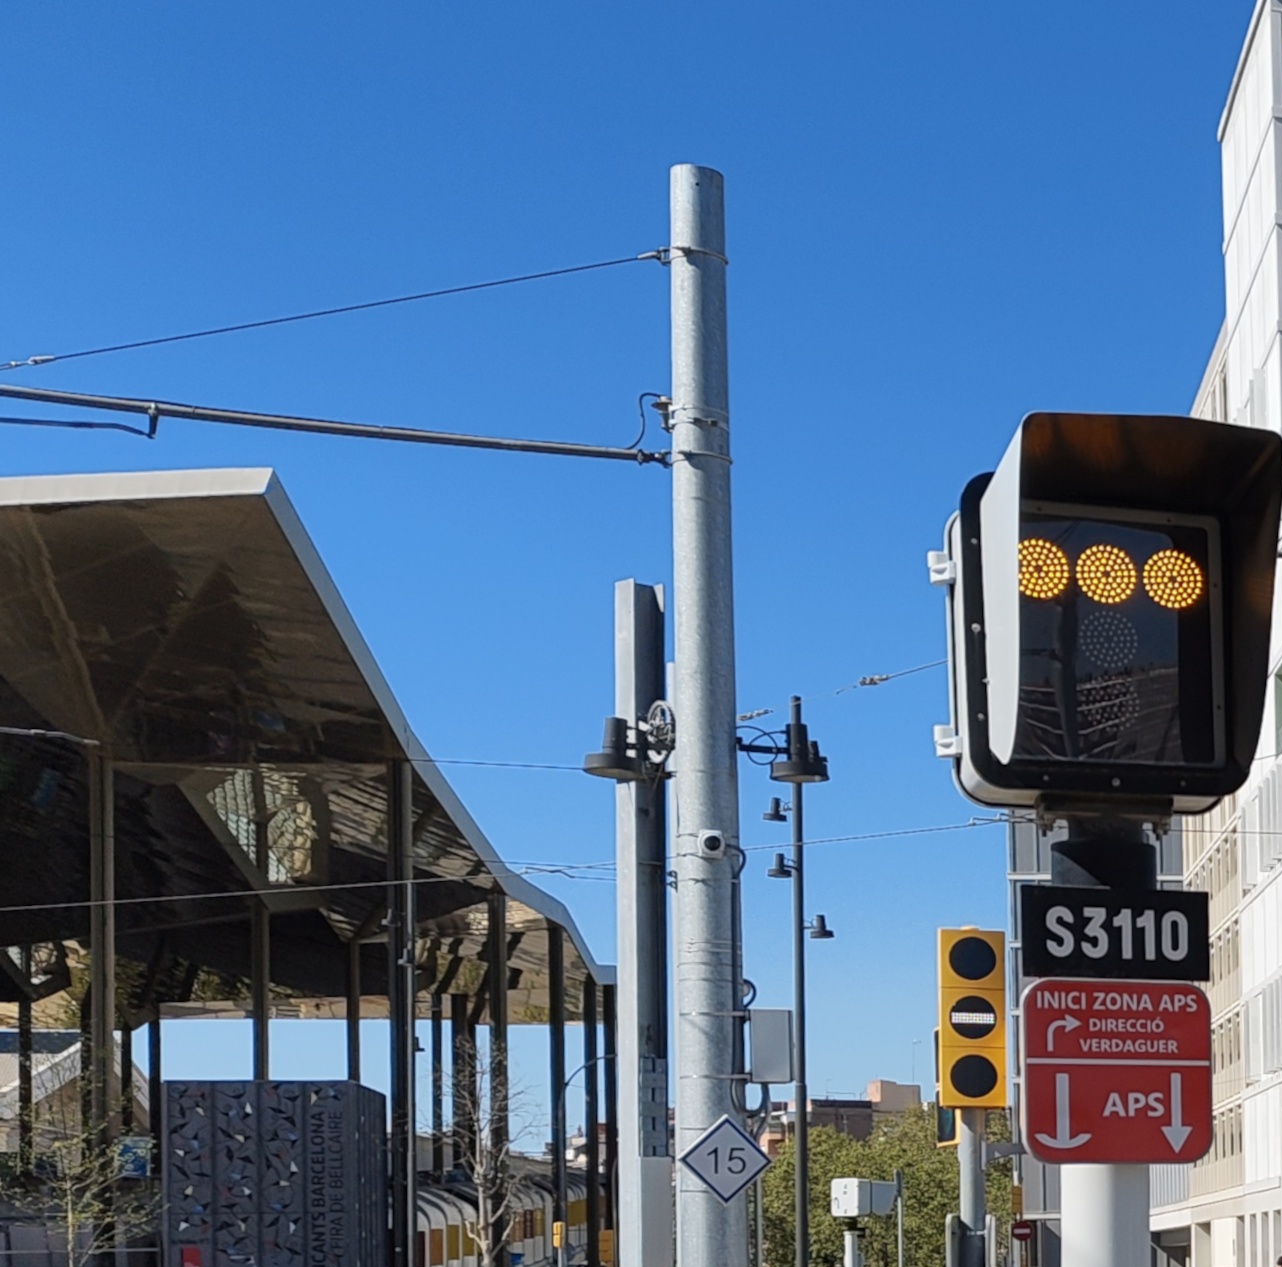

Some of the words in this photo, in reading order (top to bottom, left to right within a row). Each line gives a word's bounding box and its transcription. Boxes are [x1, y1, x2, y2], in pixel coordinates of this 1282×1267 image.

[1045, 905, 1189, 961] S3110
[1036, 990, 1087, 1010] INICI
[1092, 992, 1154, 1012] ZONA
[1158, 994, 1198, 1013] APS
[1088, 1016, 1165, 1033] DIRECCIÓ
[1078, 1038, 1179, 1054] VERDAGUER
[1102, 1091, 1166, 1118] APS
[309, 1110, 327, 1208] BARCELONA
[326, 1110, 344, 1190] BELLCAIRE
[706, 1146, 747, 1175] 15
[327, 1192, 345, 1214] DE
[327, 1216, 346, 1254] FIRA
